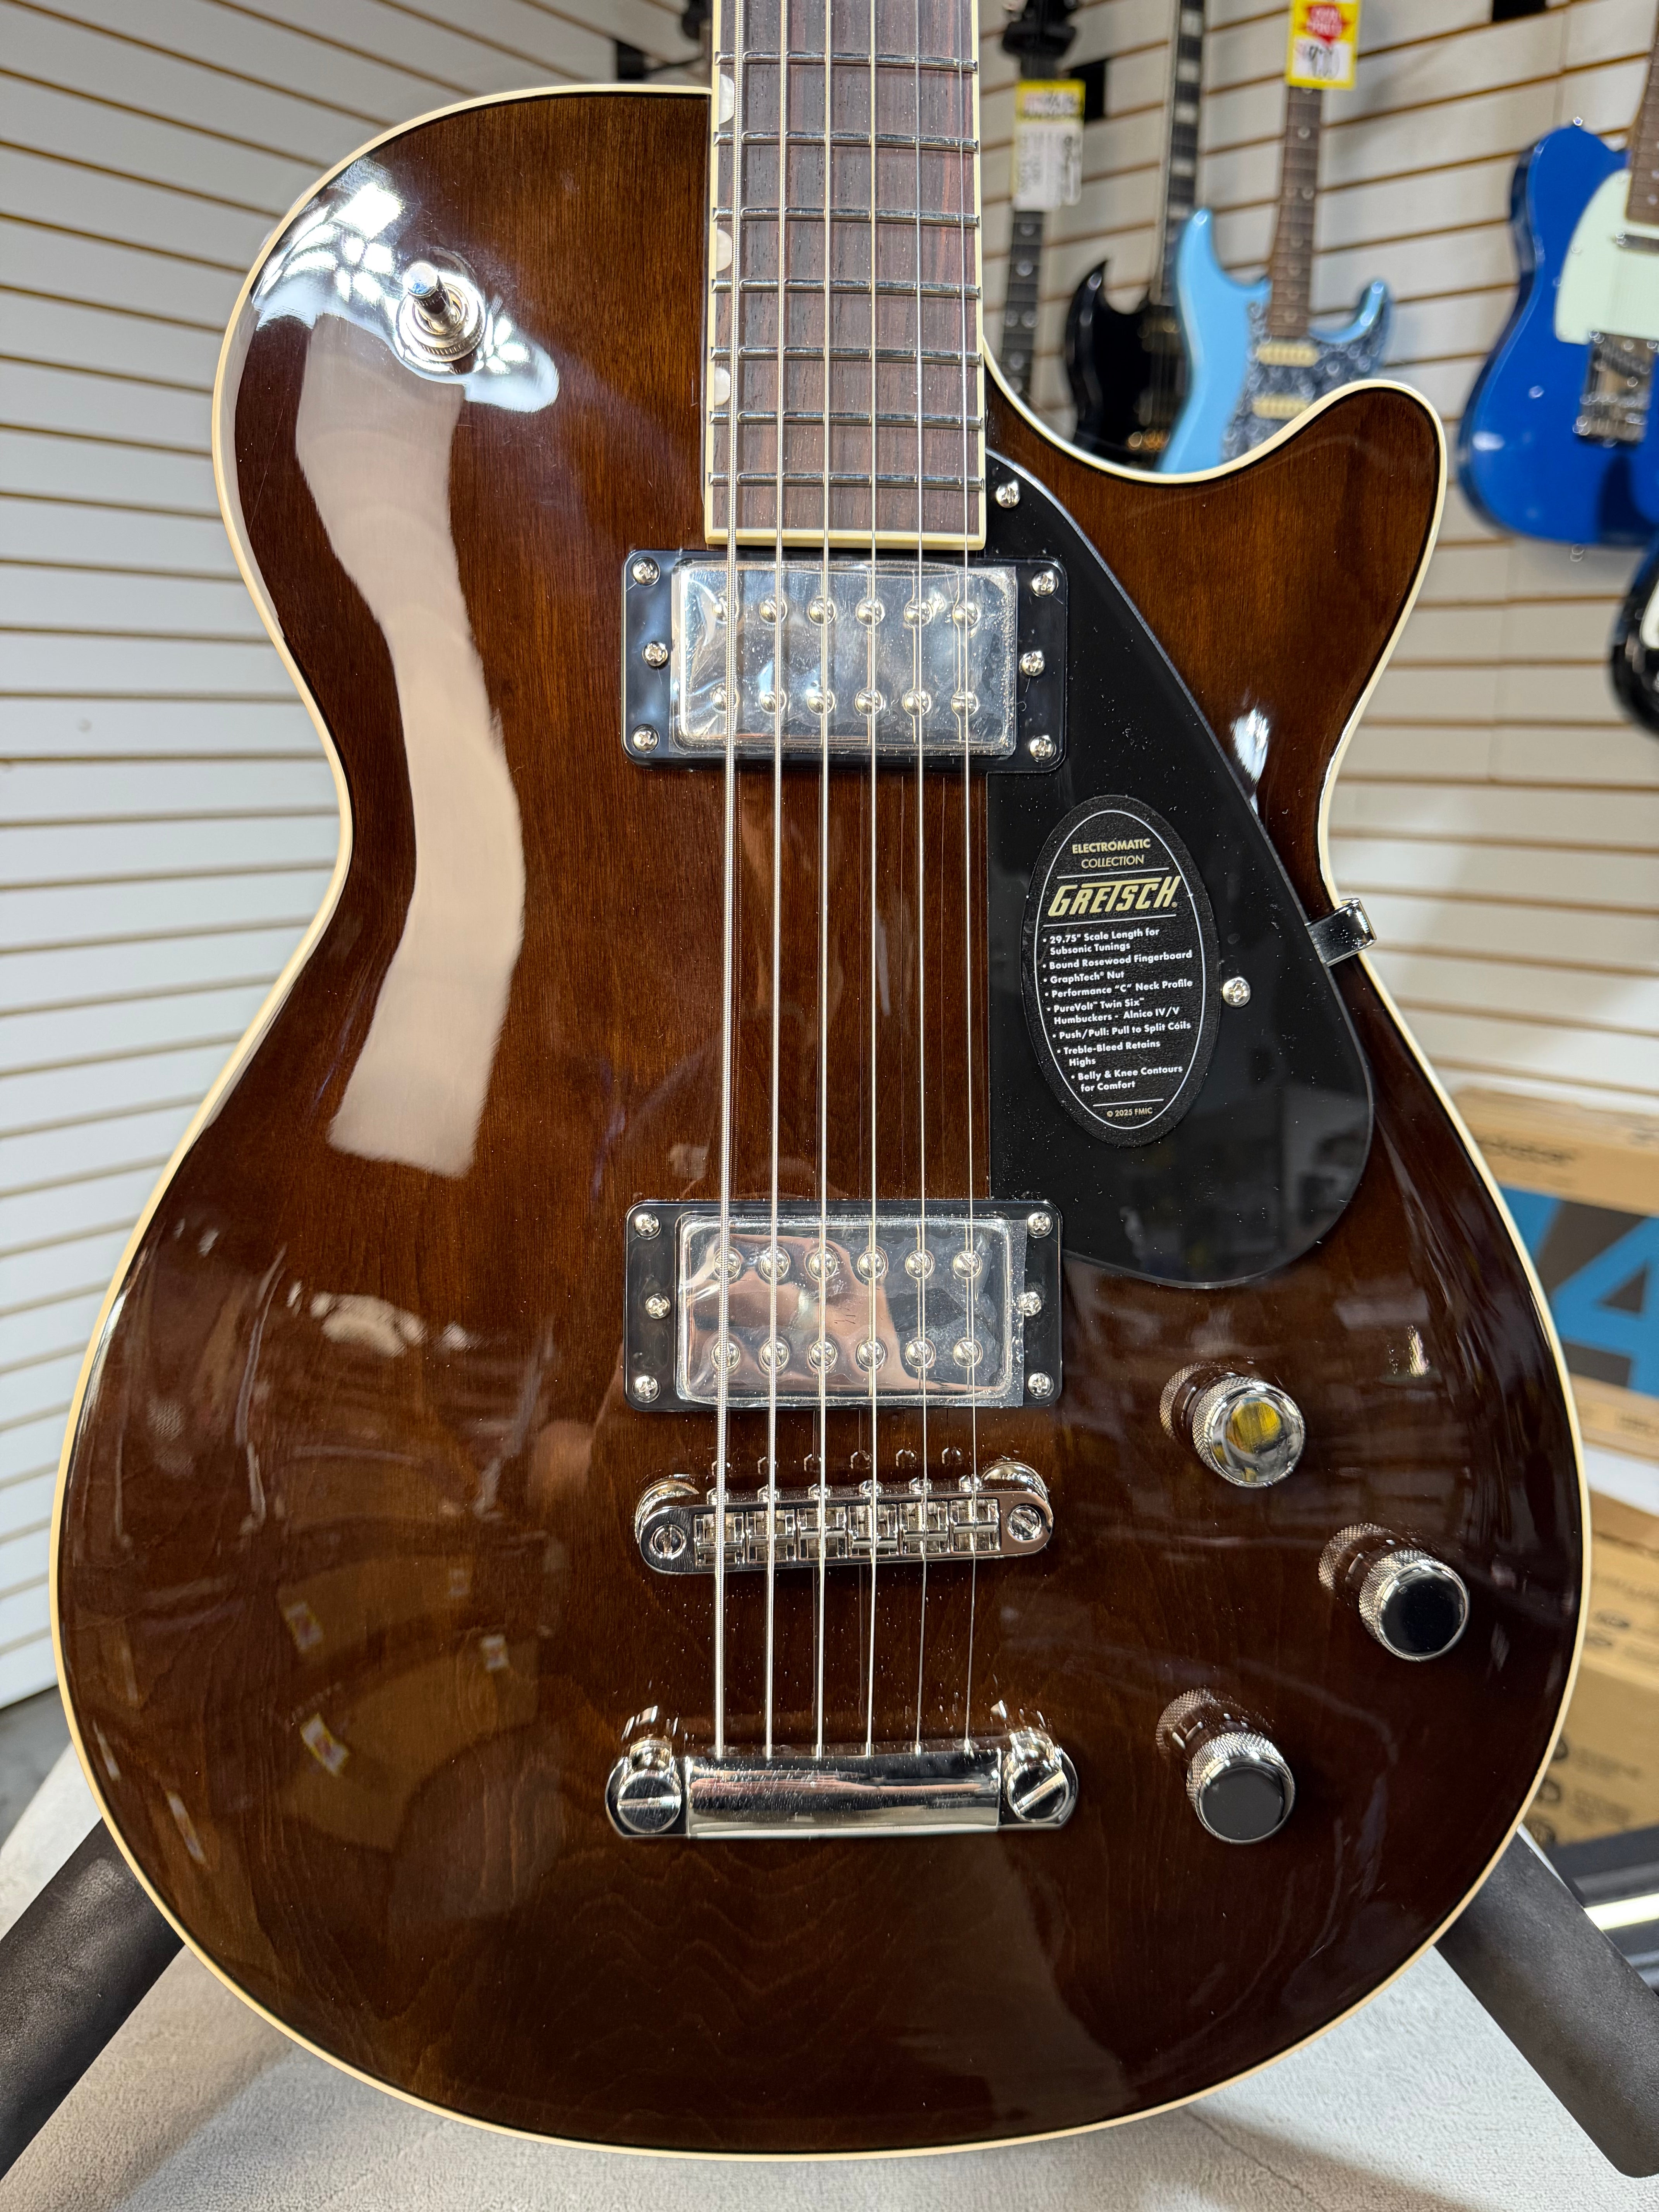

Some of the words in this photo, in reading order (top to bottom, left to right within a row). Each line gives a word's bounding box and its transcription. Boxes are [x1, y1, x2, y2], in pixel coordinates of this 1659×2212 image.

[1072, 838, 1151, 854] ELECTROMATIC
[1081, 855, 1145, 869] COLLECTION
[1050, 934, 1081, 944] 29.75"
[1084, 932, 1109, 941] Scale
[1112, 930, 1143, 939] Length
[1145, 927, 1160, 936] for
[1050, 945, 1092, 955] Subsonic
[1094, 942, 1130, 952] Tunings
[1049, 959, 1079, 970] Bound
[1082, 955, 1131, 967] Rosewood
[1134, 950, 1192, 963] Fingerboard
[1107, 971, 1124, 979] Nut
[1052, 987, 1112, 998] Performance
[1135, 981, 1159, 991] Neck
[1162, 979, 1193, 989] Profile
[1100, 1000, 1122, 1009] Twin
[1054, 1013, 1112, 1025] Humbuckers
[1123, 1010, 1152, 1019] Alnico
[1155, 1007, 1180, 1017] IV/V
[1060, 1029, 1109, 1039] Push/Pull:
[1144, 1024, 1165, 1034] Split
[1063, 1043, 1123, 1054] Treble-Bleed
[1125, 1040, 1161, 1049] Retains
[1069, 1057, 1096, 1067] Highs
[1078, 1071, 1101, 1081] Belly
[1114, 1069, 1138, 1077] Knee
[1140, 1066, 1183, 1075] Contours
[1080, 1084, 1095, 1092] for
[1097, 1081, 1135, 1091] Comfort
[1135, 1107, 1152, 1115] FMIC
